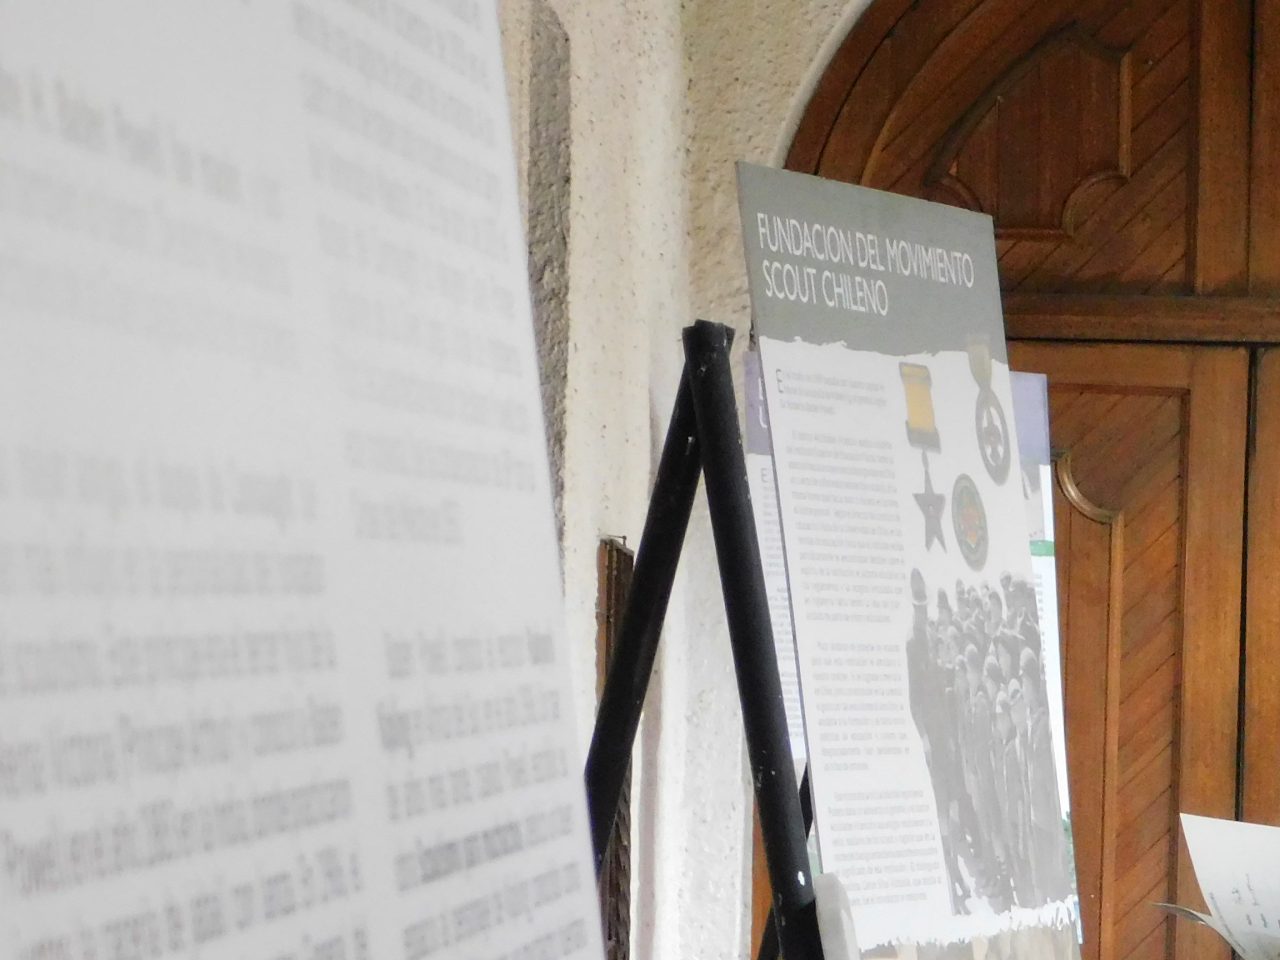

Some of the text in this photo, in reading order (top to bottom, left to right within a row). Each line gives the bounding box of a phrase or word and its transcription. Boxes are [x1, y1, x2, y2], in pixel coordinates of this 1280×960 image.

[757, 212, 975, 288] FUNDACION DEL MOVIMIENTO
[762, 259, 889, 317] SCOUT CHILENO
